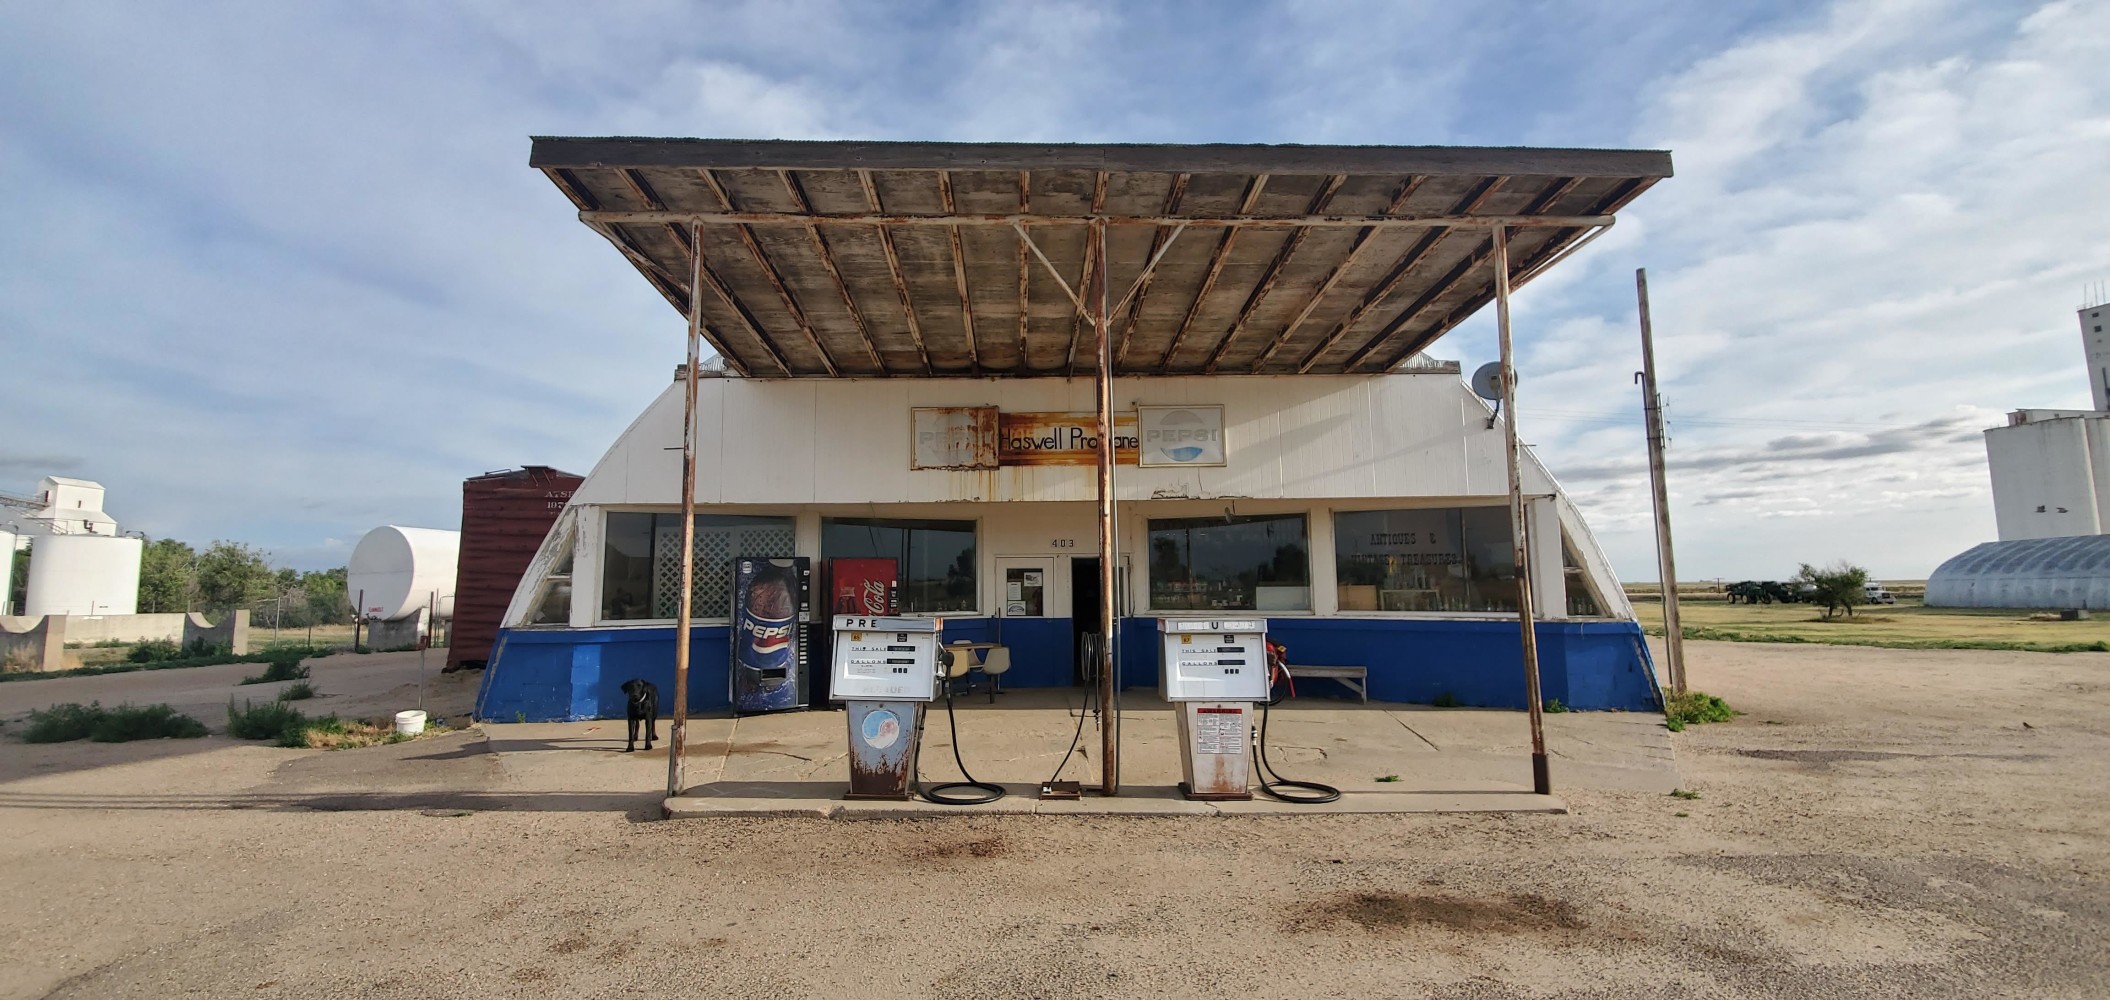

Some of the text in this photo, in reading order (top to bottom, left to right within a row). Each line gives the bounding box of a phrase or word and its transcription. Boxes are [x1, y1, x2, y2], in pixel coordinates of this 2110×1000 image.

[999, 427, 1139, 450] Haswell Proane
[1146, 429, 1217, 442] PEPSI
[1051, 539, 1074, 548] 403
[1370, 532, 1417, 545] ANTIQUES
[743, 618, 793, 639] PEPSI
[1211, 620, 1219, 630] U
